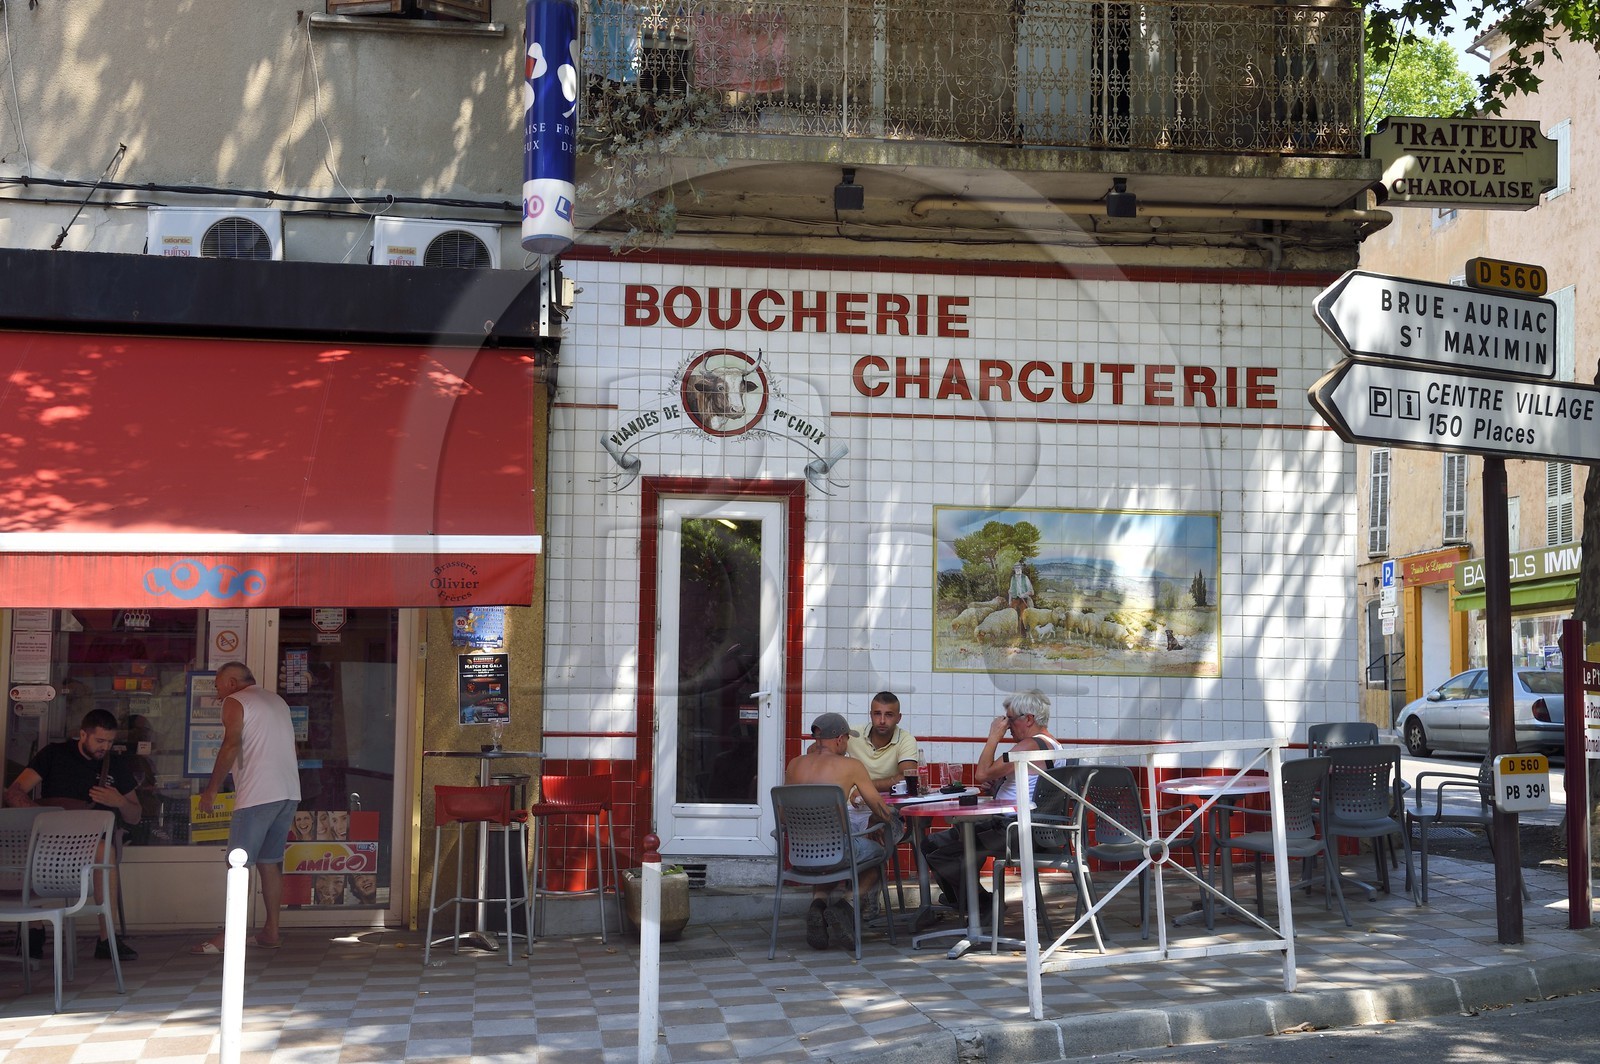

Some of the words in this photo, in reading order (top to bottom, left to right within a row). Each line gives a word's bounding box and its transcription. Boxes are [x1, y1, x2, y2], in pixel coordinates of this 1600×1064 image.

[1391, 122, 1538, 150] TRAITEUR
[1417, 156, 1506, 176] VIANDE
[1391, 177, 1535, 200] CHAROLAISE
[164, 247, 191, 256] FUJITSU
[389, 256, 415, 265] FUJITSU
[1480, 258, 1491, 283] D
[1500, 262, 1541, 290] 560
[625, 286, 968, 338] BOUCHERIE
[1444, 330, 1547, 365] MAXIMIN
[852, 356, 1278, 408] CHARCUTERIE
[1427, 382, 1504, 412] CENTRE
[1516, 391, 1594, 421] VILLAGE
[610, 410, 659, 447] VIANDES
[663, 404, 681, 421] DE
[788, 415, 827, 445] CHOIX
[1429, 413, 1462, 438] 150
[1474, 418, 1535, 445] Places
[143, 559, 267, 600] LOTO
[433, 561, 478, 576] Brasserie
[430, 577, 479, 589] Olivier
[438, 591, 473, 602] Frères
[1583, 667, 1591, 685] Le
[1508, 760, 1517, 773] D
[1520, 758, 1540, 771] 560
[1506, 784, 1521, 801] PB
